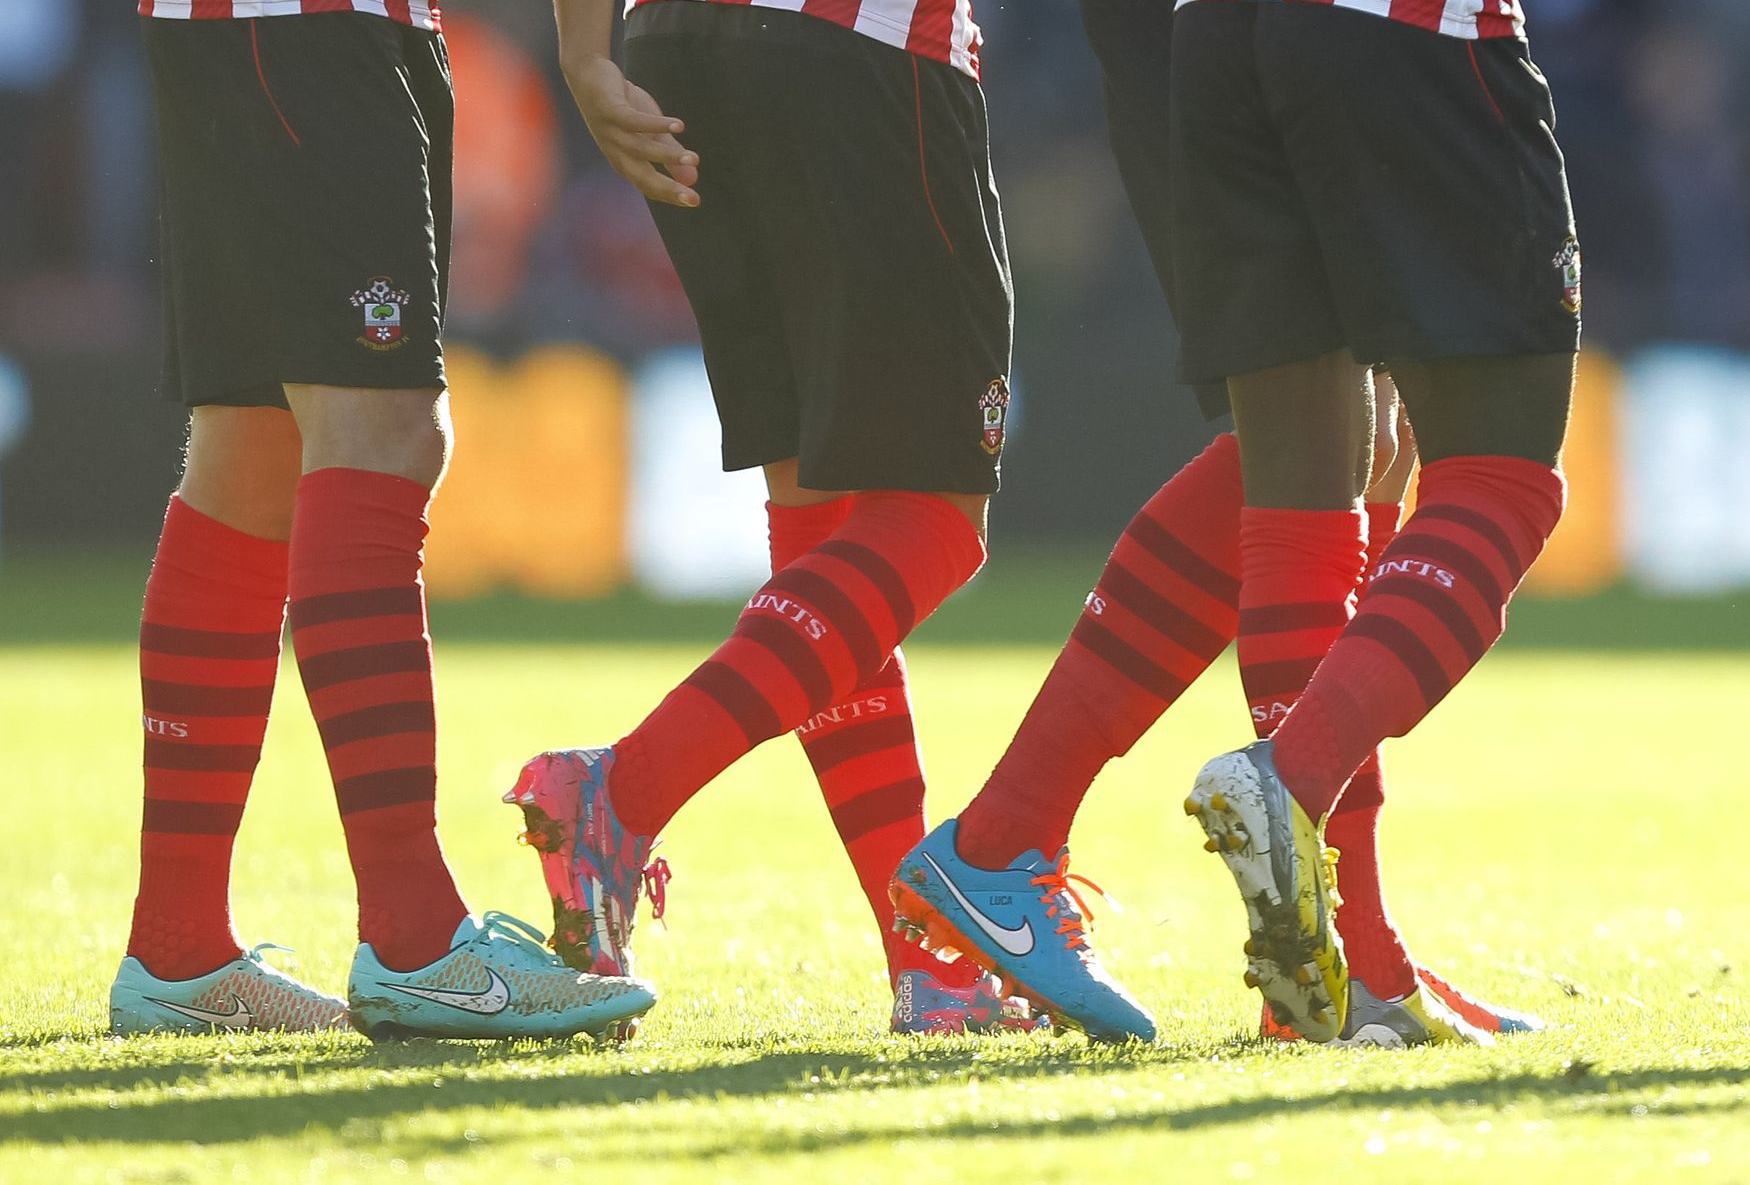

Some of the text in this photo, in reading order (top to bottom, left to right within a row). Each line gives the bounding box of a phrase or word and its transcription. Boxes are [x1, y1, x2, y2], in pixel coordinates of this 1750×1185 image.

[1369, 559, 1455, 588] INTS
[989, 895, 1013, 906] LUCA
[903, 975, 913, 1022] adidas
